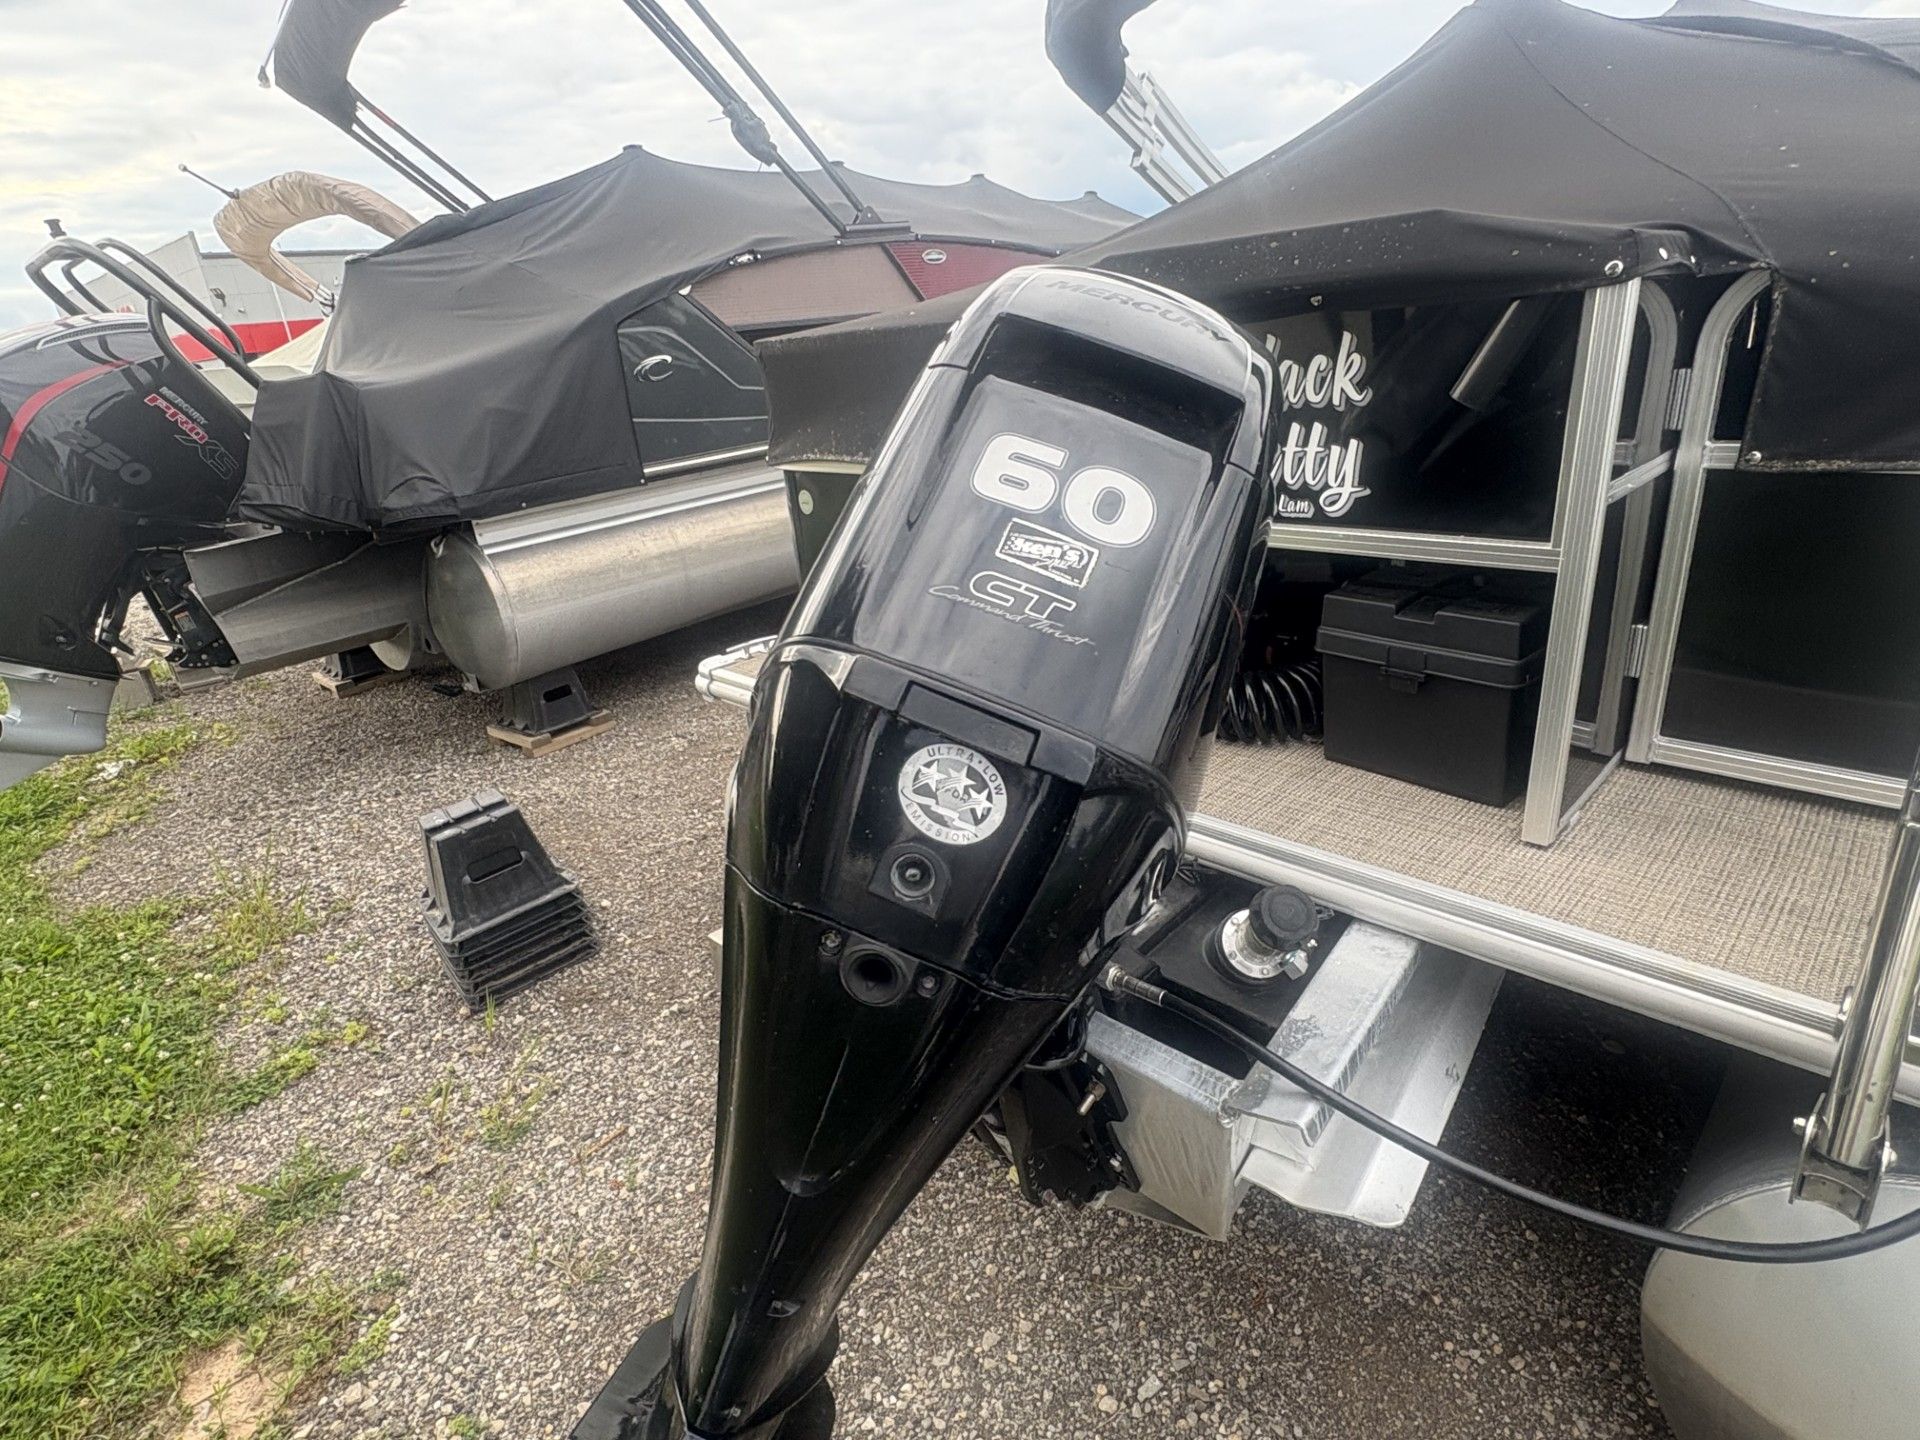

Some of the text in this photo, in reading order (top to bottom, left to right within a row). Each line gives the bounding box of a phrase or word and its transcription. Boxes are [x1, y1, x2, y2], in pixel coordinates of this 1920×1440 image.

[1046, 280, 1233, 343] MERCURY
[1266, 331, 1373, 411] ack
[144, 393, 239, 480] PRO XS
[159, 386, 208, 425] MERCURY
[54, 430, 152, 485] 250
[1270, 422, 1371, 517] tty
[970, 432, 1157, 548] 60
[929, 585, 1096, 646] Command Thrust
[904, 801, 970, 841] EMISSION
